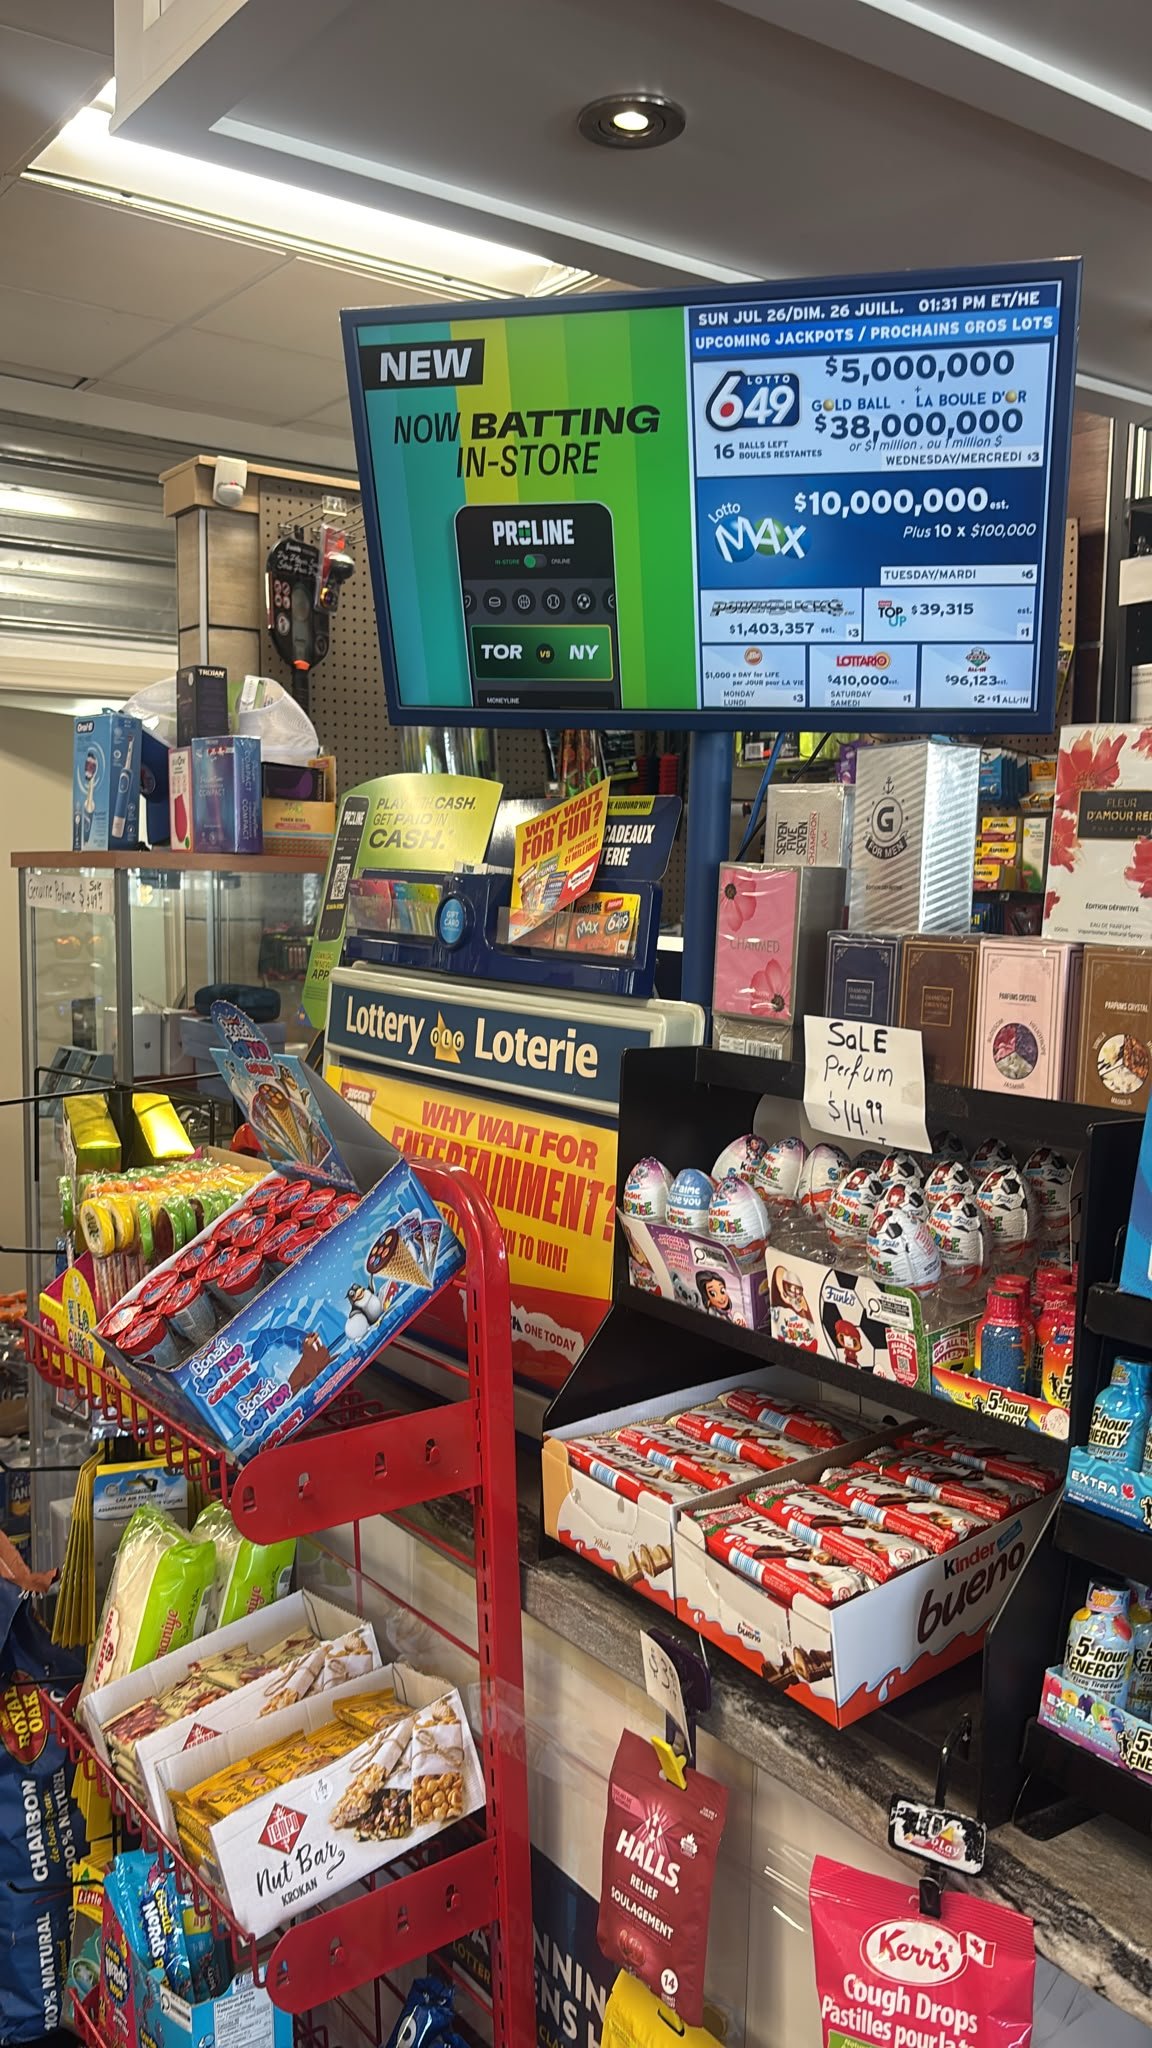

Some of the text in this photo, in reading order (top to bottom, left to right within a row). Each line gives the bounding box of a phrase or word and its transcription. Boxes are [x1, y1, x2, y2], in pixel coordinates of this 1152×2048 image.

[698, 291, 1040, 326] SUN JUL 26/DIM. 26 JUILL. 01:31 PM ET/HE
[695, 315, 1053, 350] UPCOMING JACKPOTS PROCHAINS GROS LOTS
[379, 347, 472, 382] NEW
[825, 350, 1014, 387] $5,000,000
[747, 375, 790, 385] LOTTO
[710, 375, 796, 428] 649
[857, 397, 891, 410] BALL
[916, 395, 933, 408] LA
[939, 392, 986, 406] BOULE
[394, 404, 660, 444] NOW BATTING
[815, 408, 1023, 444] $38,000,000
[713, 443, 735, 459] 16
[739, 440, 789, 450] BALLS LEFT
[739, 449, 822, 460] BOULES RESTANTES
[849, 443, 862, 452] or
[952, 437, 991, 449] million
[456, 441, 600, 478] IN-STORE
[886, 451, 1022, 466] WEDNESDAY/MERCREDI
[707, 501, 741, 525] Lotto
[794, 487, 989, 518] $10,000,000
[492, 519, 575, 546] PROLINE
[714, 516, 807, 564] MAX
[903, 522, 1037, 539] Plus 10 $100,000
[884, 568, 977, 581] TUESDAY/MARDI
[878, 606, 903, 619] TOP
[889, 615, 907, 628] UP
[911, 603, 974, 617] $39,315
[729, 622, 815, 637] $1,403,357
[481, 644, 599, 660] TOR NY
[836, 652, 890, 669] LOTTARIO
[705, 671, 731, 680] $1,000
[827, 673, 889, 687] $410,000
[945, 674, 997, 688] $96,123
[723, 690, 755, 698] MONDAY
[830, 690, 872, 698] SATURDAY
[830, 699, 861, 707] SAMEDI
[434, 796, 476, 810] CASH.
[525, 787, 603, 838] WHY WAIT
[1087, 810, 1133, 822] D'AMOUR
[1107, 798, 1137, 808] FLEUR
[373, 813, 393, 826] GET
[876, 806, 895, 833] G
[521, 800, 603, 867] FOR FUN?
[776, 821, 788, 855] SEVEN
[787, 827, 798, 851] FIVE
[796, 821, 808, 855] SEVEN
[868, 838, 905, 857] FOR MEN
[730, 939, 780, 953] CHARMED
[1105, 1001, 1148, 1013] PARFUMS CRYSTAL
[346, 995, 425, 1056] Lottery
[475, 1018, 599, 1079] Loterie
[824, 1055, 894, 1087] Perfum
[421, 1101, 599, 1172] WHY WAIT FOR
[519, 1232, 569, 1273] TO WIN!
[825, 1286, 856, 1307] Funko
[524, 1323, 577, 1352] ONE TODAY
[191, 1339, 230, 1376] Bonart
[237, 1379, 276, 1417] Bonart
[988, 1390, 1027, 1415] 5-hour
[654, 1428, 710, 1452] bueno
[602, 1447, 656, 1469] bueno
[1071, 1470, 1118, 1497] EXTRA
[594, 1536, 611, 1551] White
[742, 1518, 808, 1548] bueno
[943, 1538, 996, 1580] Kinder
[917, 1541, 1026, 1645] bueno
[737, 1621, 761, 1644] bueno
[1076, 1635, 1128, 1663] 5-hour
[1069, 1656, 1126, 1679] ENERGY
[5, 1685, 30, 1749] ROYAL
[22, 1690, 44, 1734] OAK
[1047, 1693, 1096, 1727] EXTRA
[53, 1767, 71, 1828] NATUREL
[21, 1780, 49, 1882] CHARBON
[256, 1840, 345, 1897] Nut Bar
[281, 1877, 318, 1907] KROKAN
[629, 1872, 659, 1902] RELIEF
[610, 1885, 674, 1941] SOULAGEMENT
[878, 1928, 951, 1974] Kerr's
[36, 1911, 58, 2031] 100% NATURAL
[663, 1974, 676, 1991] 14
[822, 1994, 892, 2041] Pastilles
[843, 1973, 978, 2036] Cough Drops
